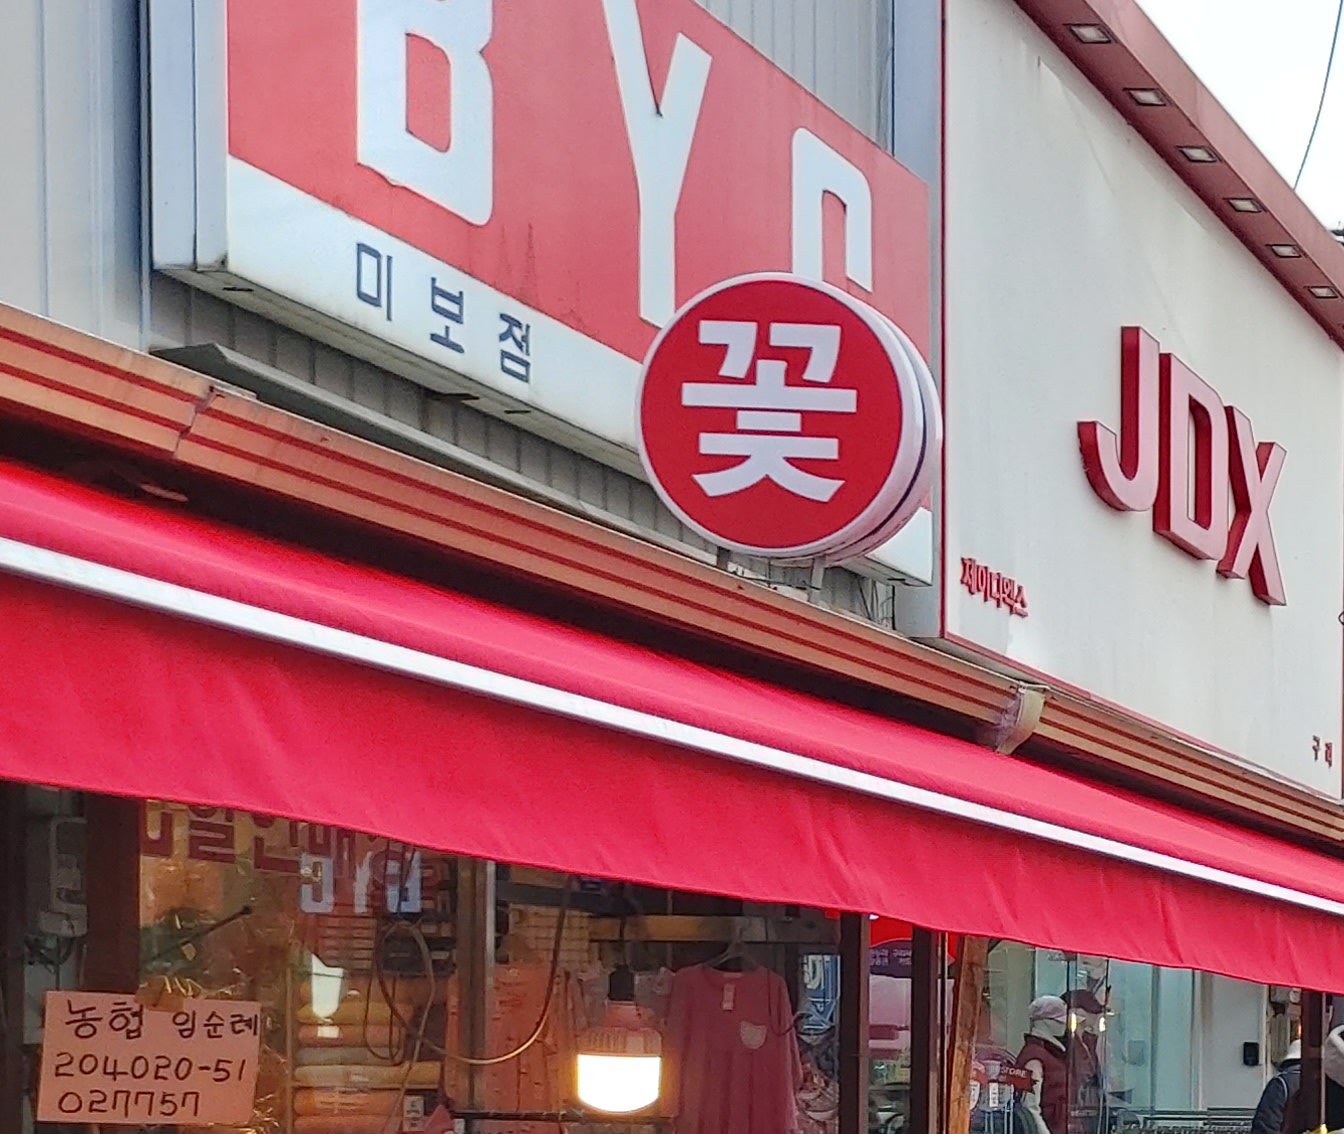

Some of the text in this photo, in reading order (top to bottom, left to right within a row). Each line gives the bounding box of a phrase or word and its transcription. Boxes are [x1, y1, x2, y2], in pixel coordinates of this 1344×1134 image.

[355, 243, 532, 385] 미보점
[682, 320, 857, 503] 꽃
[1078, 325, 1287, 606] JDX
[961, 556, 1029, 618] 제이디엑스
[1312, 735, 1333, 769] 구리
[65, 1000, 259, 1040] 농협 임순례
[55, 1051, 247, 1083] 204020-51
[58, 1089, 200, 1117] 027757
